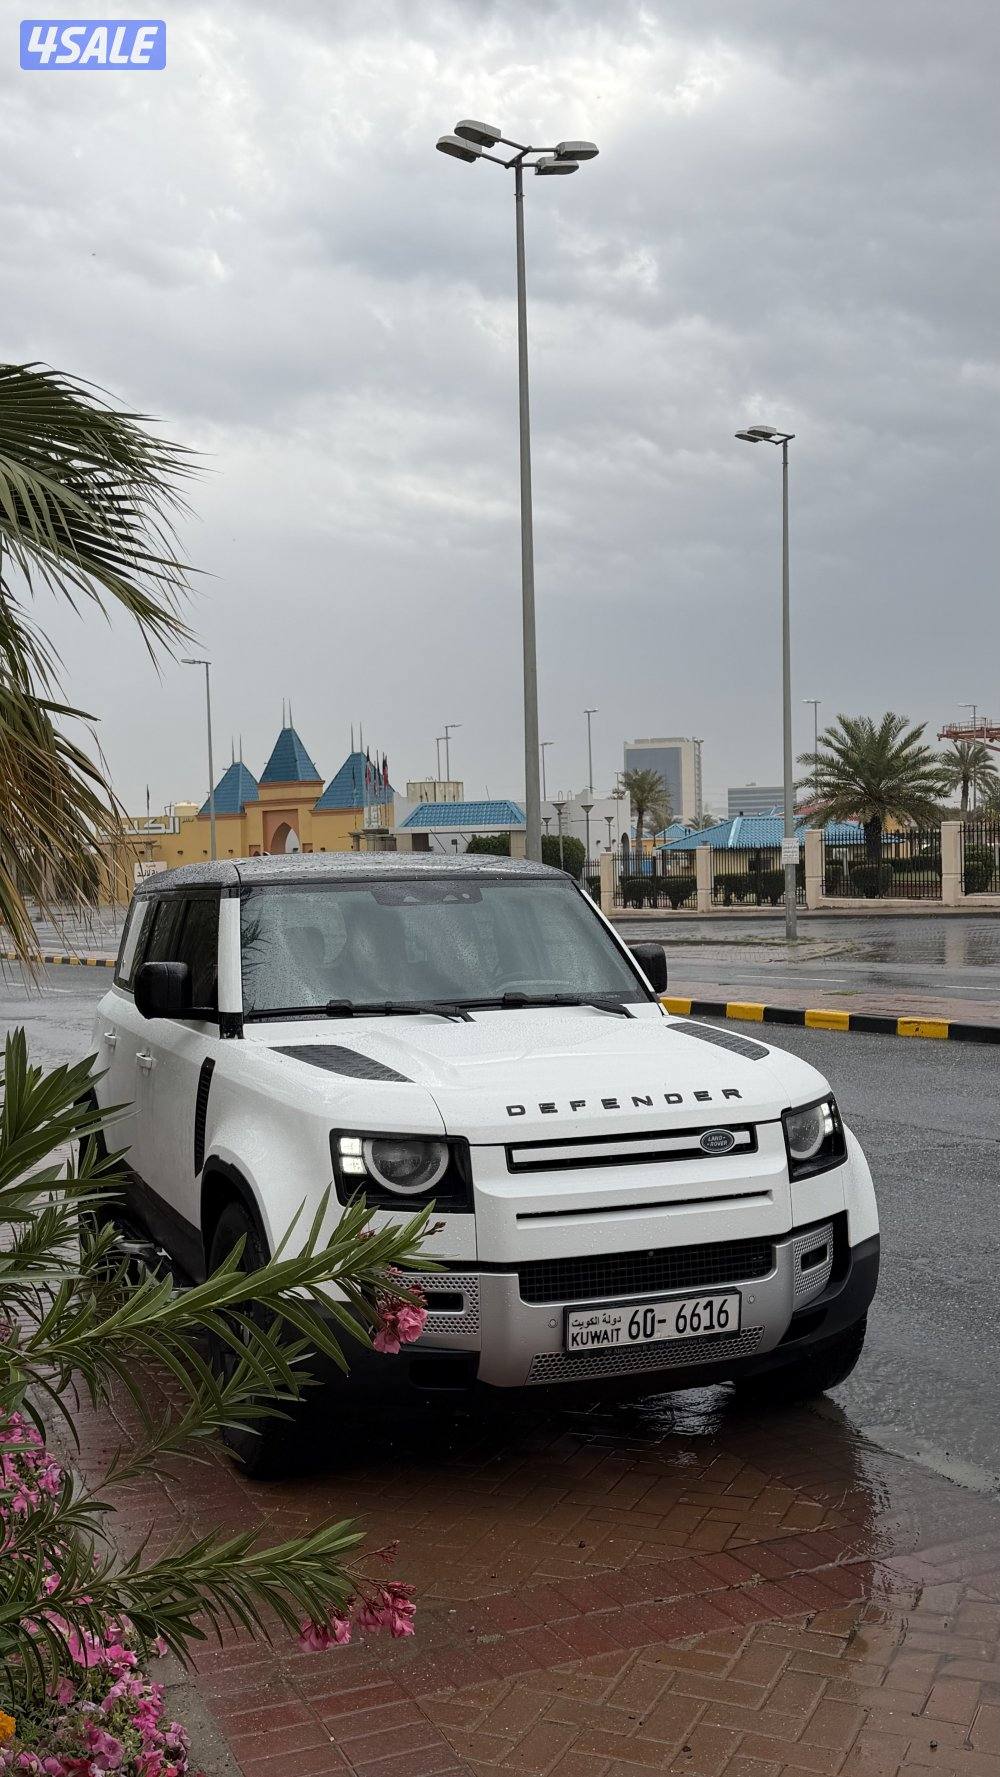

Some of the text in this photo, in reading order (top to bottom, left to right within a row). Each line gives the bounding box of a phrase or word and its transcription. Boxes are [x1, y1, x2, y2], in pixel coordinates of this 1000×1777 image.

[506, 1088, 743, 1117] DEFENDER
[571, 1313, 622, 1330] دولة الكويت
[675, 1298, 730, 1334] 6616
[571, 1328, 622, 1347] KUWAIT
